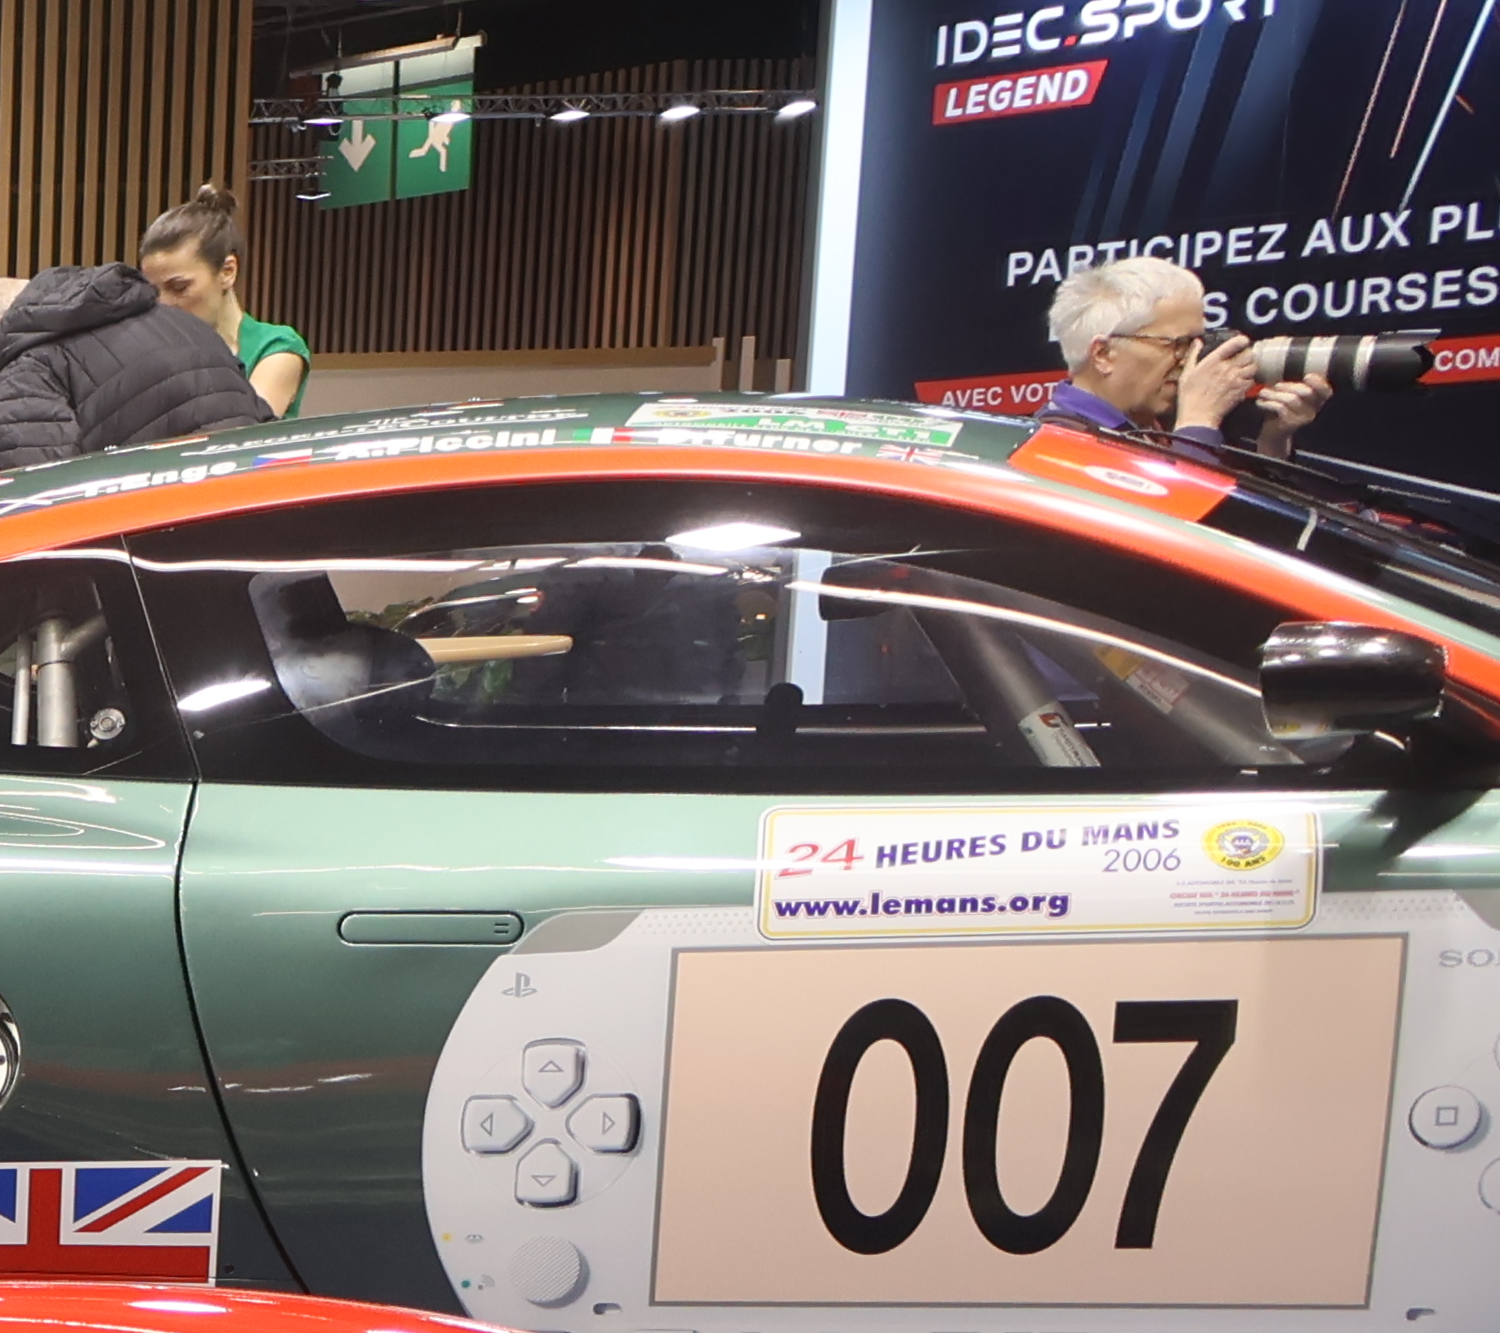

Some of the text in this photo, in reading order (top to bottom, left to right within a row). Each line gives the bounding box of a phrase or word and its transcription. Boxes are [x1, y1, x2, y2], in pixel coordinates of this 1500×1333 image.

[944, 68, 1090, 119] LEGEND
[1300, 209, 1411, 259] AUX
[1246, 266, 1500, 327] COURSES
[941, 384, 1004, 408] AVEC
[773, 817, 1182, 877] 24 HEURES DU MANS
[1102, 846, 1182, 874] 2006
[772, 889, 1071, 920] www.lemans.org
[1438, 948, 1500, 969] SO
[810, 993, 1240, 1256] 007
